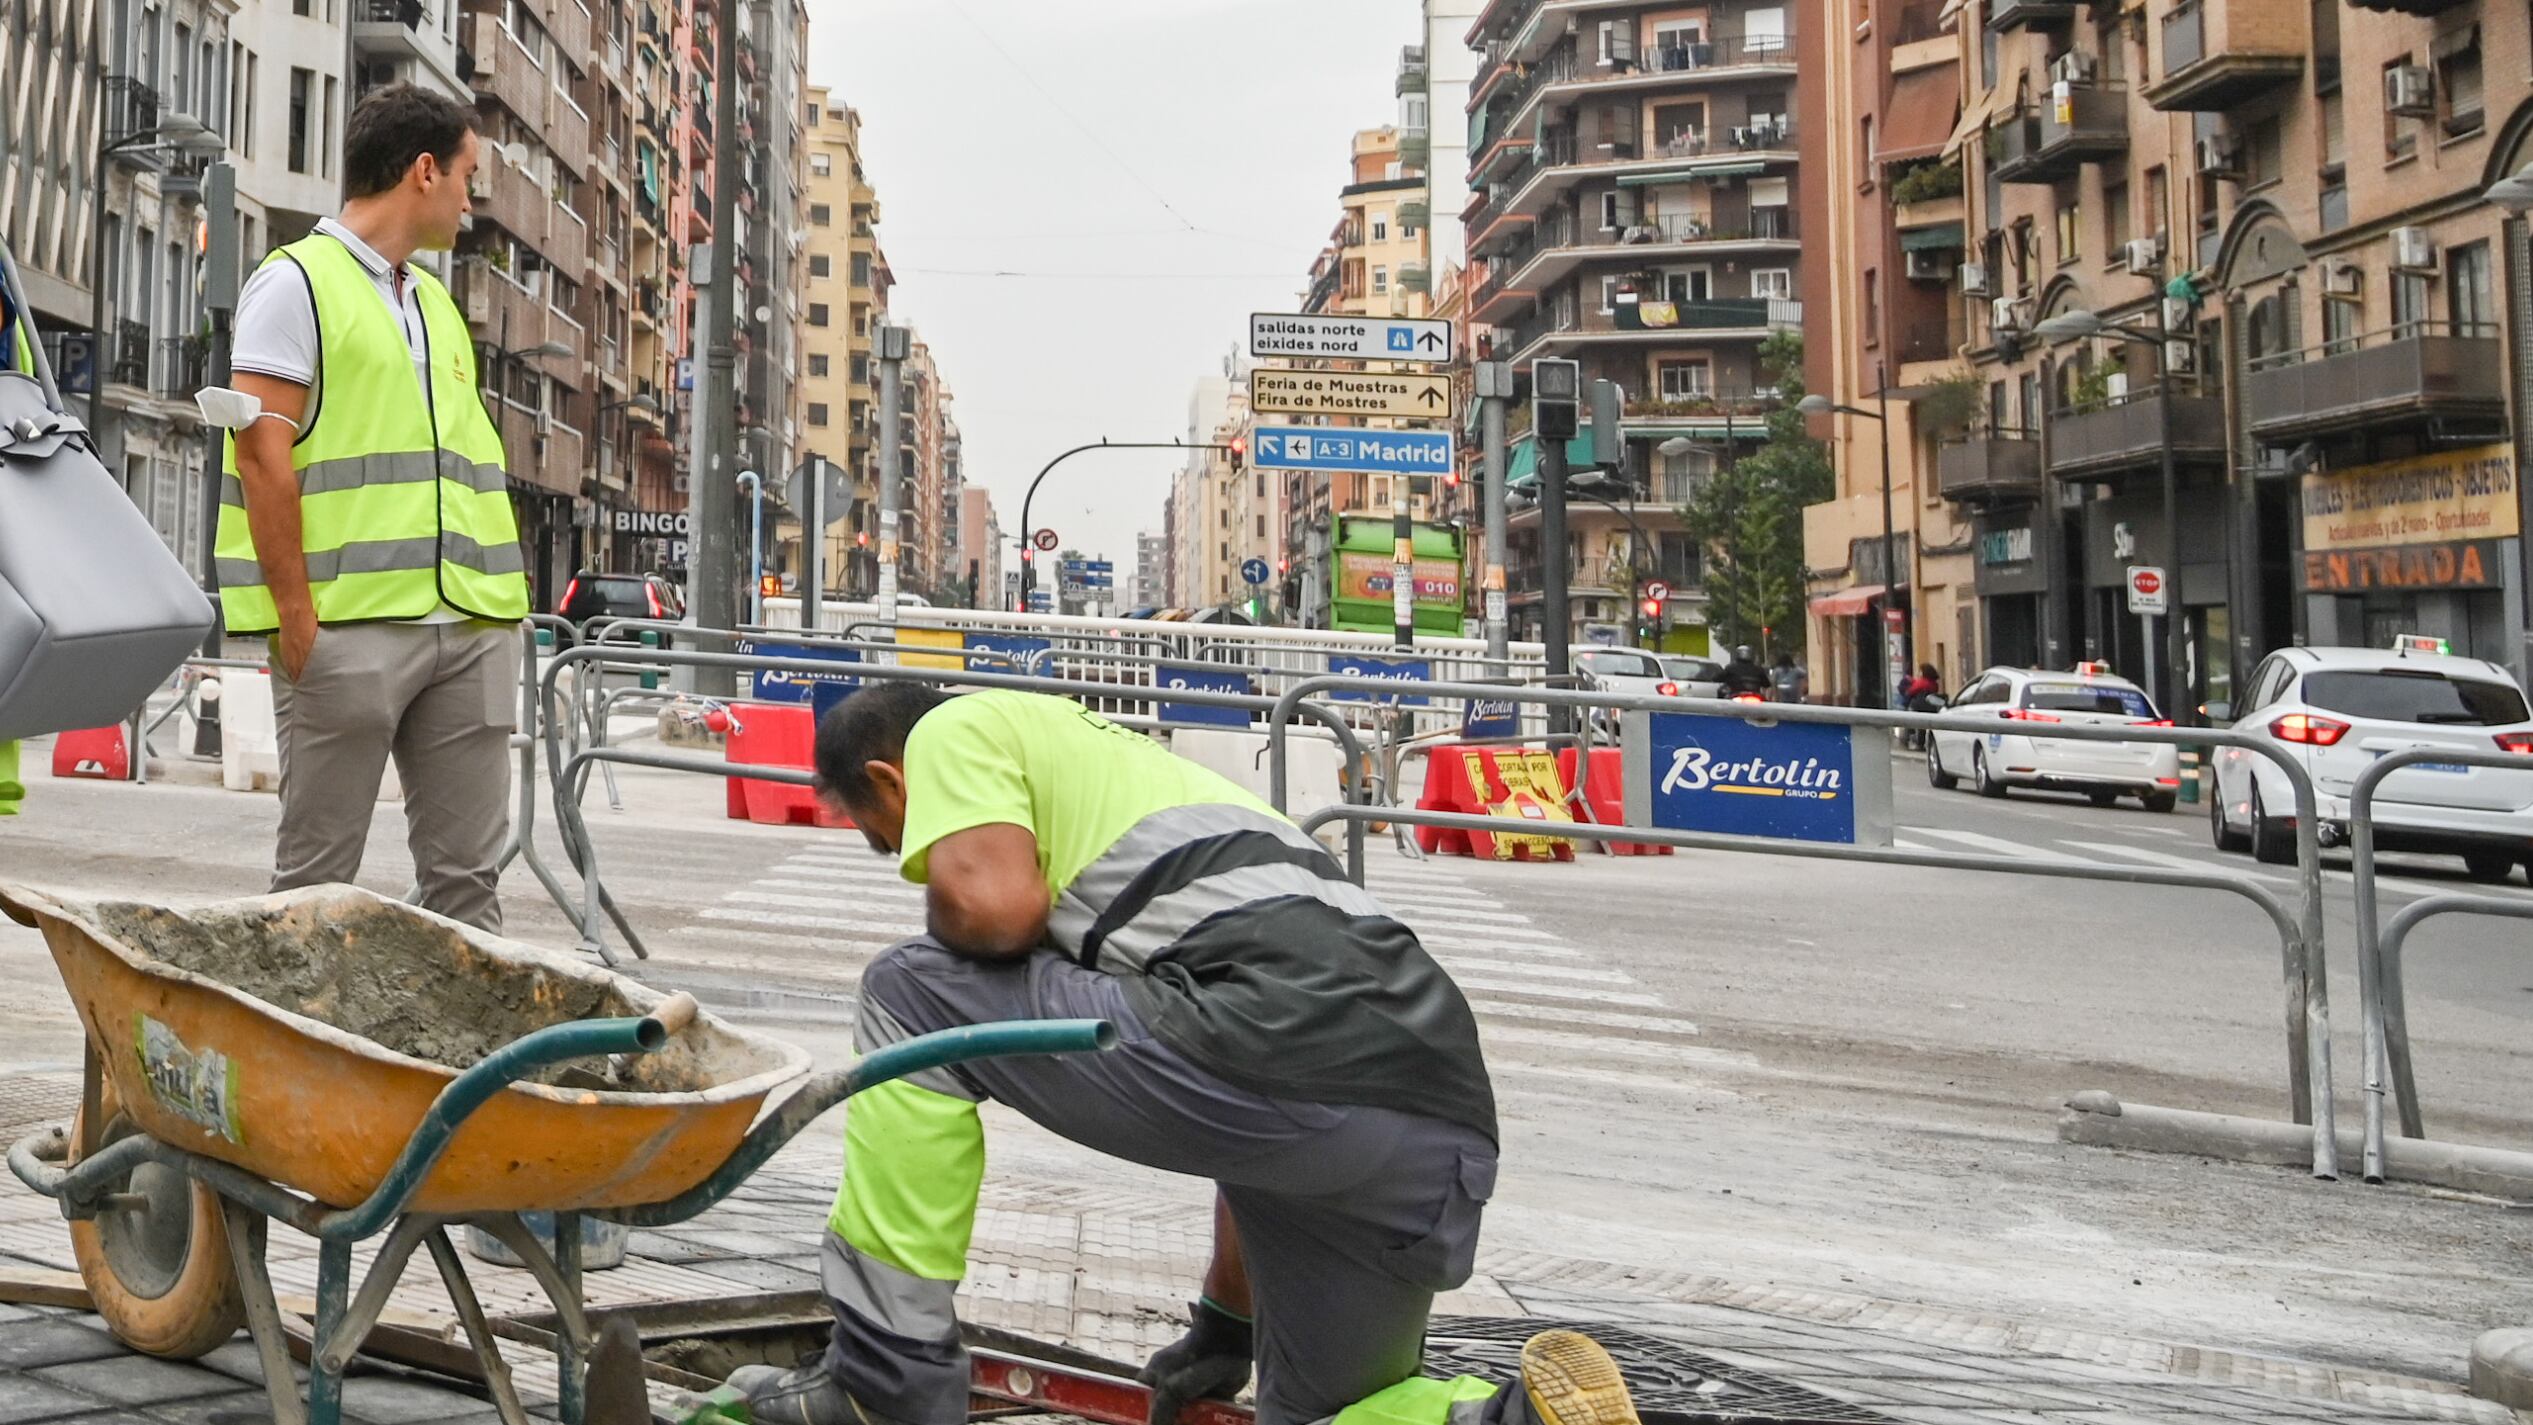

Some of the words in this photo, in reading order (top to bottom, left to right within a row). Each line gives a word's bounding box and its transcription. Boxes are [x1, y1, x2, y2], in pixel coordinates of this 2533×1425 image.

[1258, 321, 1315, 335] salidas
[1322, 324, 1366, 337] norte
[1258, 337, 1314, 351] eixides
[1321, 339, 1358, 352] nord
[1258, 377, 1297, 390] Feria
[1303, 379, 1323, 391] de
[1330, 380, 1408, 394] Muestras
[1258, 393, 1288, 406] Fira
[1294, 395, 1314, 406] de
[1320, 395, 1388, 409] Mostres
[1319, 442, 1350, 457] A-3
[1359, 441, 1447, 464] Madrid
[615, 512, 688, 534] BINGO
[672, 541, 688, 561] P
[2305, 546, 2485, 589] ENTRADA
[1425, 581, 1455, 594] 010
[2135, 578, 2159, 587] STOP
[1785, 789, 1818, 800] GRUPO
